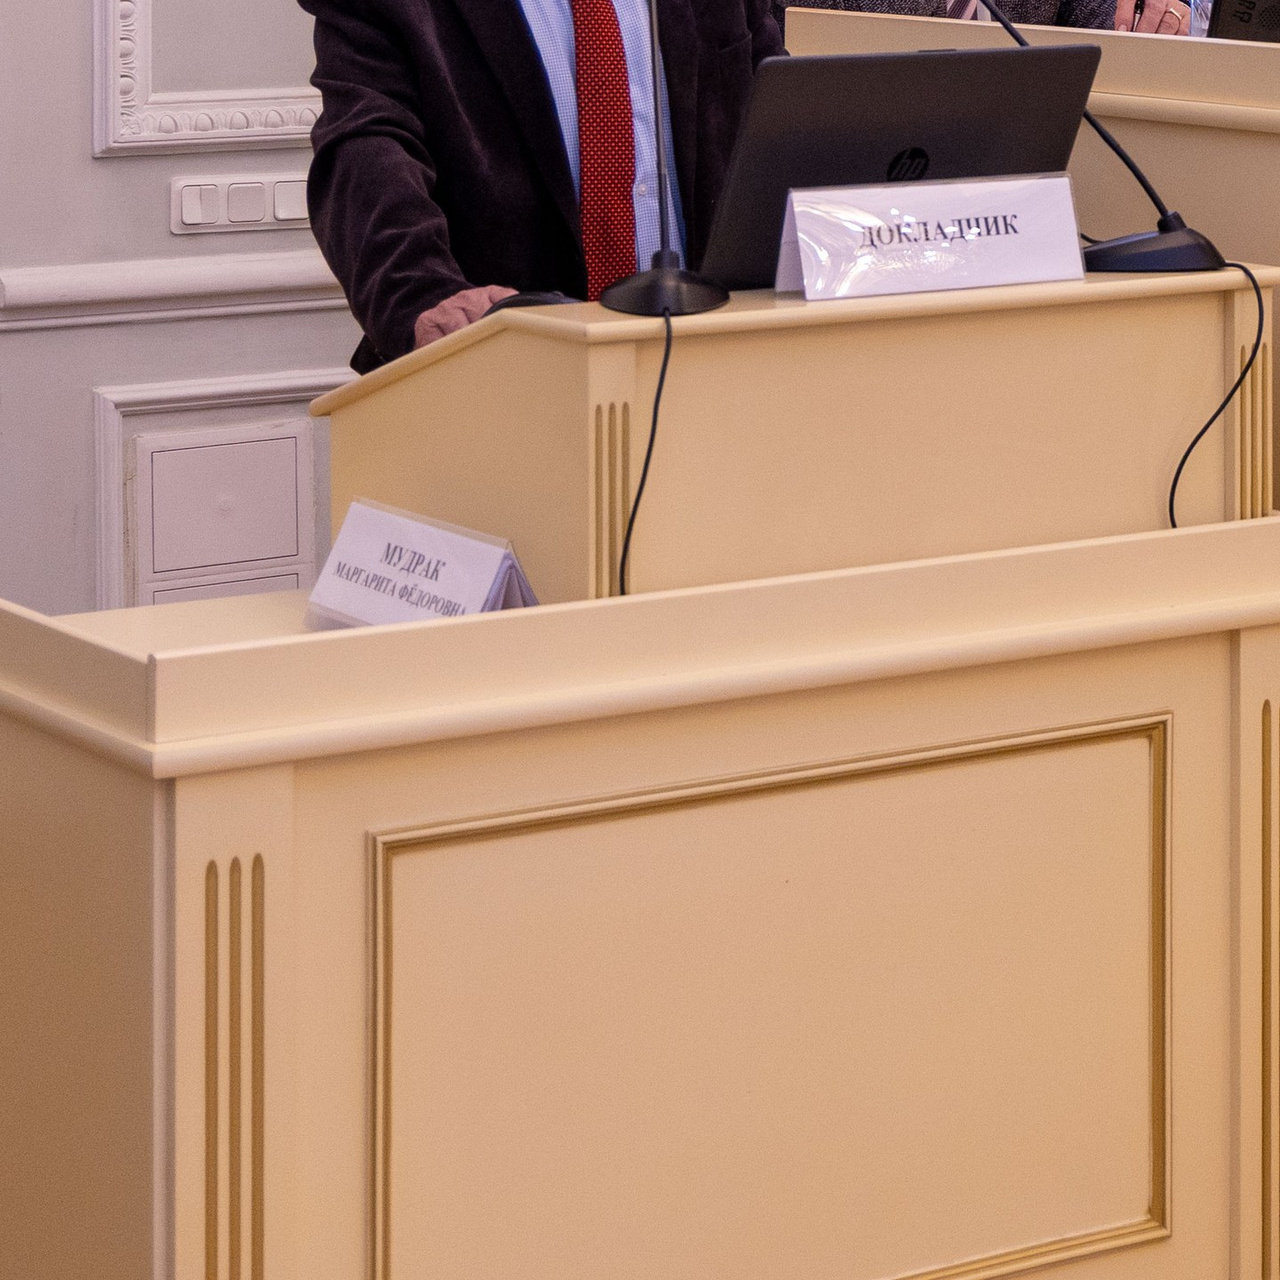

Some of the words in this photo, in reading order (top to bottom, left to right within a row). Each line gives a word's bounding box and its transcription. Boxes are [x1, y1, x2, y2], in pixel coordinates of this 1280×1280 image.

[859, 213, 1019, 249] ДОКЛАДЧИК
[333, 561, 398, 598] МАРГАРИТА
[380, 542, 447, 582] МУДРАК
